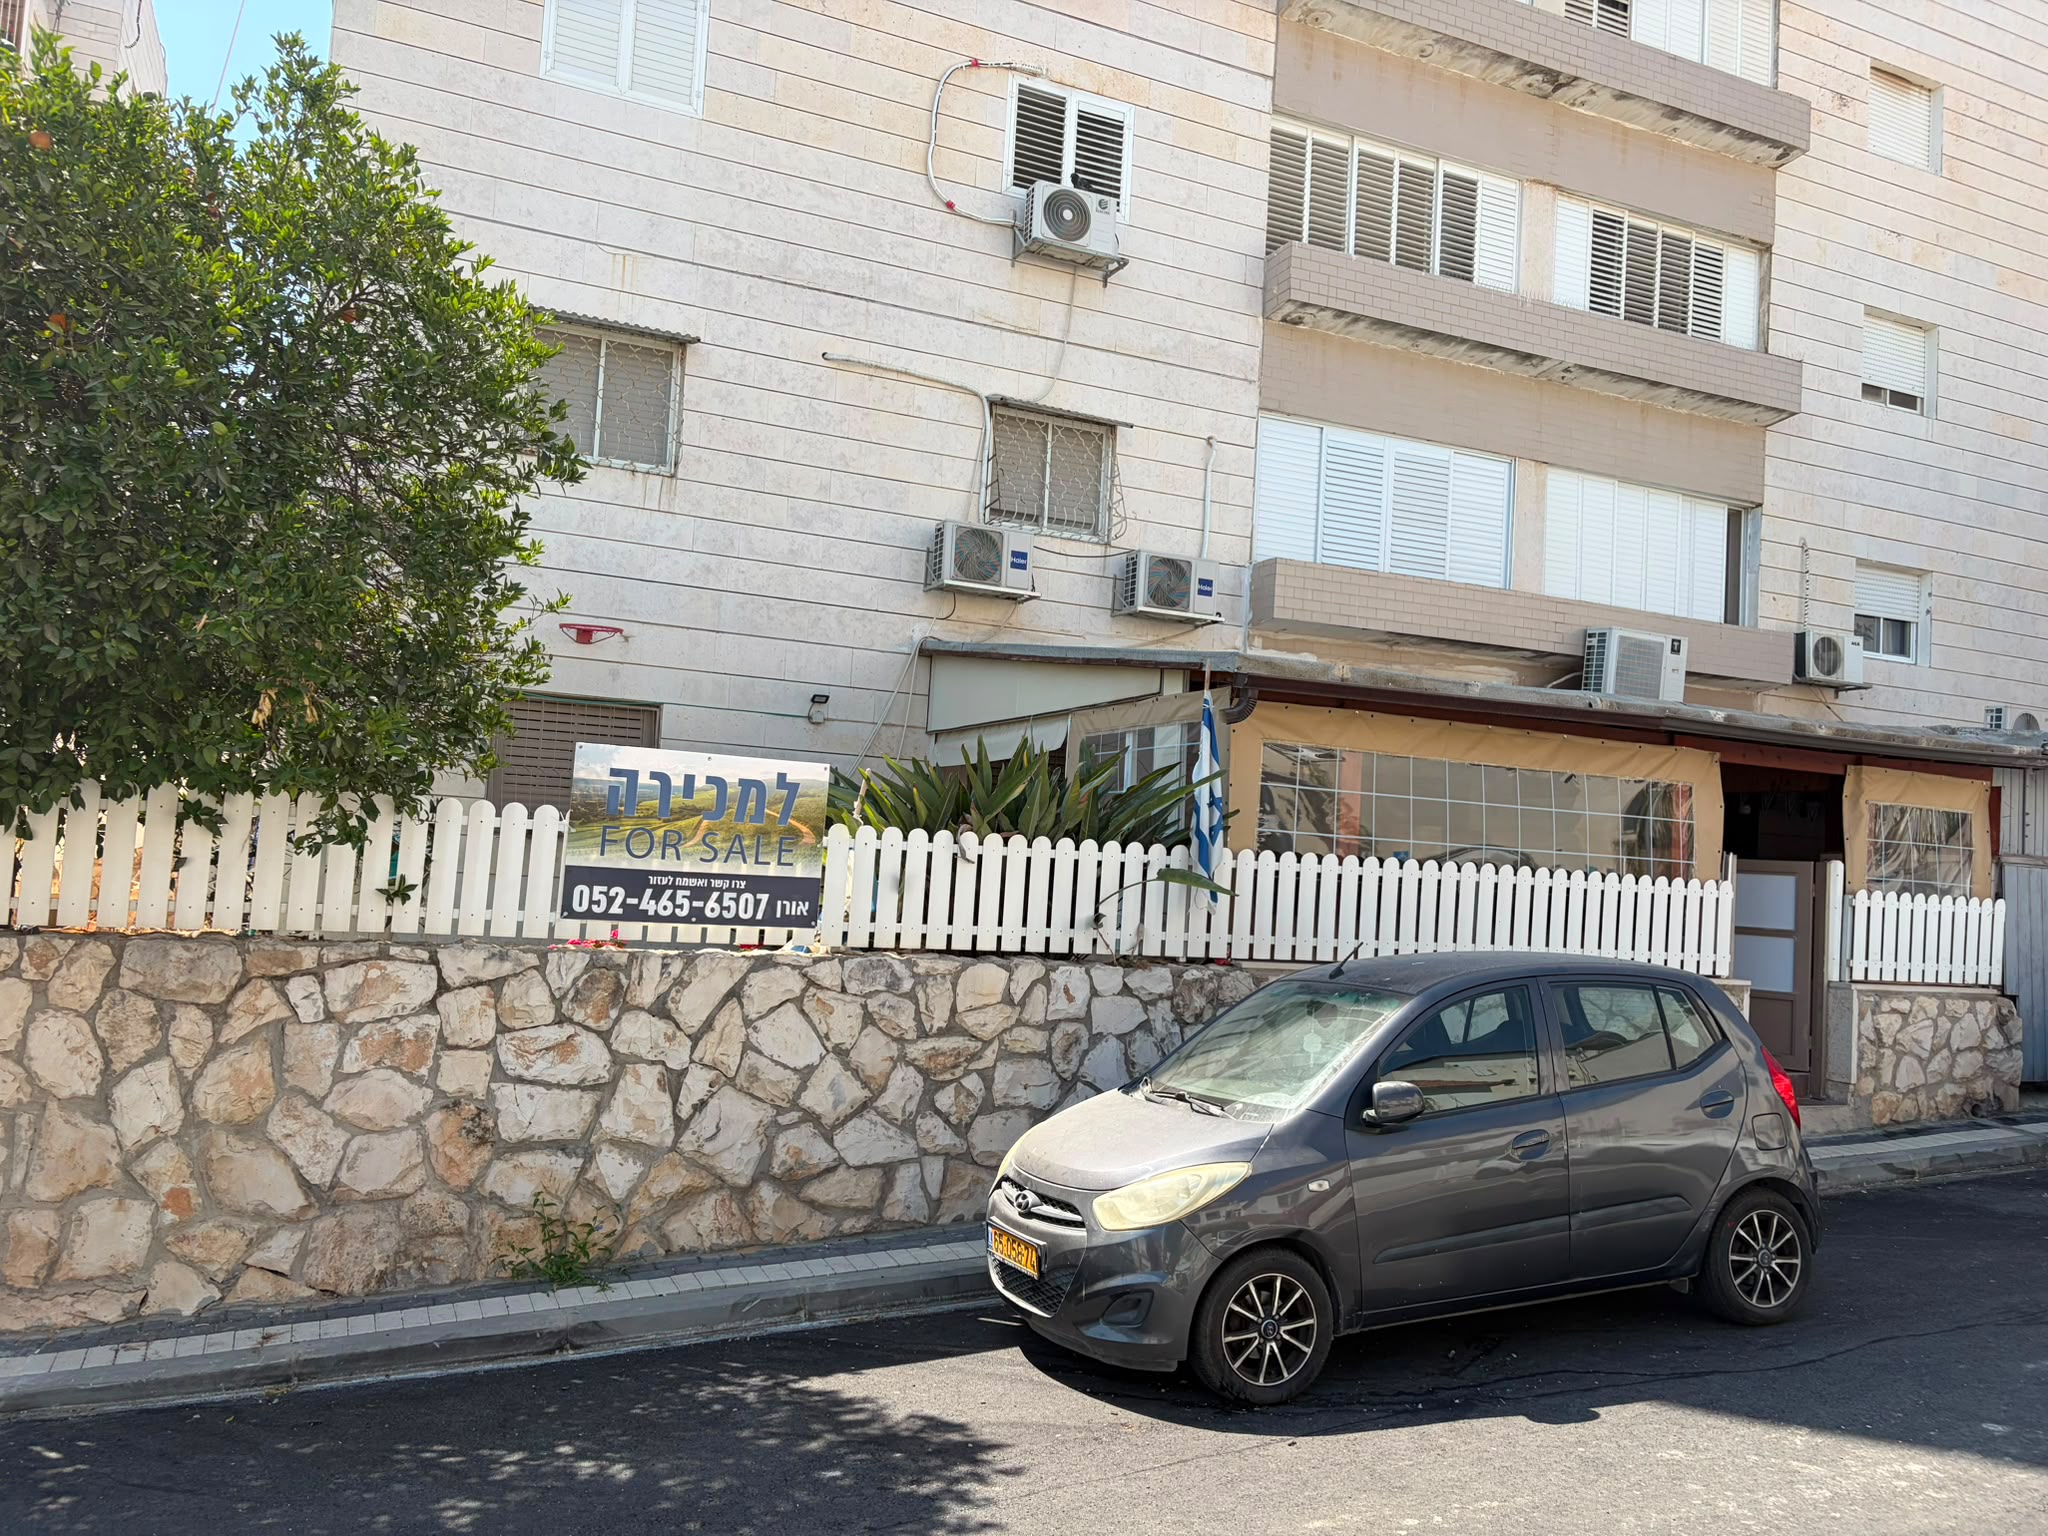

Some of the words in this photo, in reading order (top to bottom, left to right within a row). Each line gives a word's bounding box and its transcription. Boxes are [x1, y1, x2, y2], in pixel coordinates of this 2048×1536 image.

[607, 768, 800, 826] למכירה
[600, 825, 684, 861] FOR
[700, 831, 796, 867] SALE
[648, 875, 674, 886] לעזור
[675, 877, 708, 887] ואשמח
[710, 878, 729, 889] קשר
[731, 879, 746, 889] צרו
[572, 884, 769, 920] 052-465-6507
[776, 900, 809, 918] אורן
